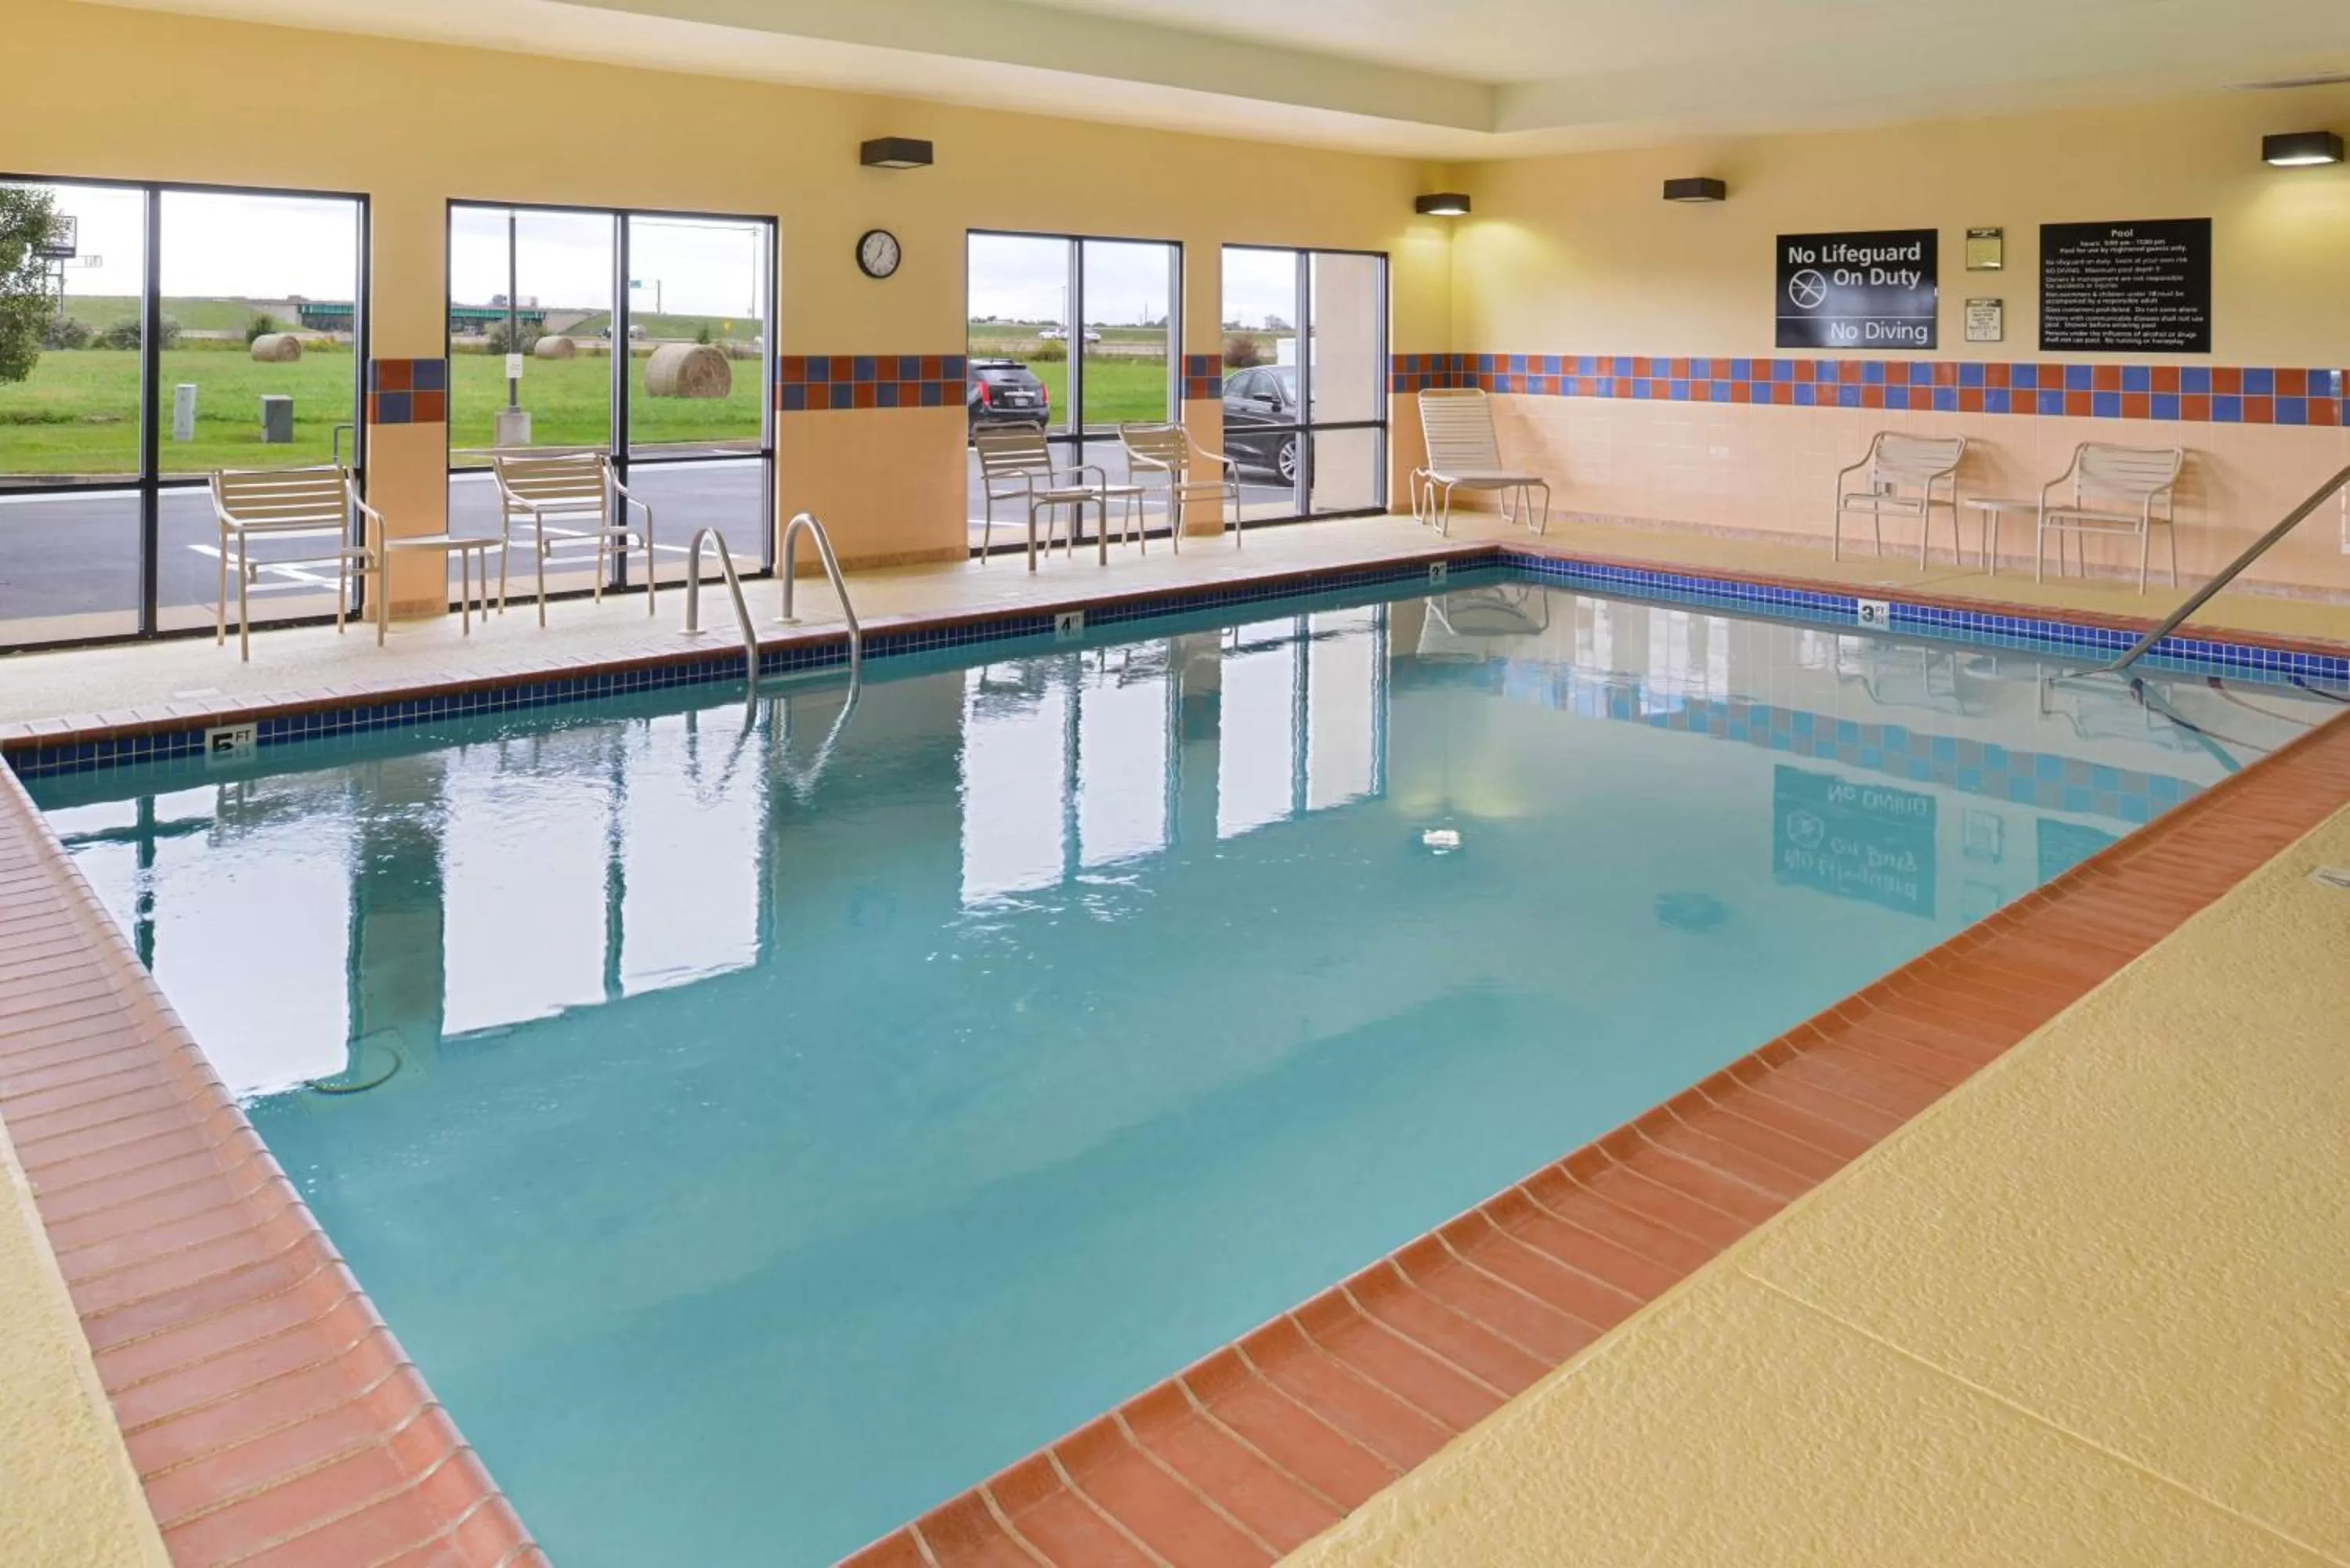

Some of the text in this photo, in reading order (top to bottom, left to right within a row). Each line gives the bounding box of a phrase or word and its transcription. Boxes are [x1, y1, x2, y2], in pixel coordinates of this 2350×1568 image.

[2111, 229, 2133, 237] Pool
[1788, 241, 1921, 267] No Lifeguard
[1834, 267, 1921, 290] On Duty
[1831, 320, 1928, 345] No Diving
[1061, 617, 1070, 630] 4
[1862, 605, 1875, 621] 3
[212, 729, 251, 751] 5 FT
